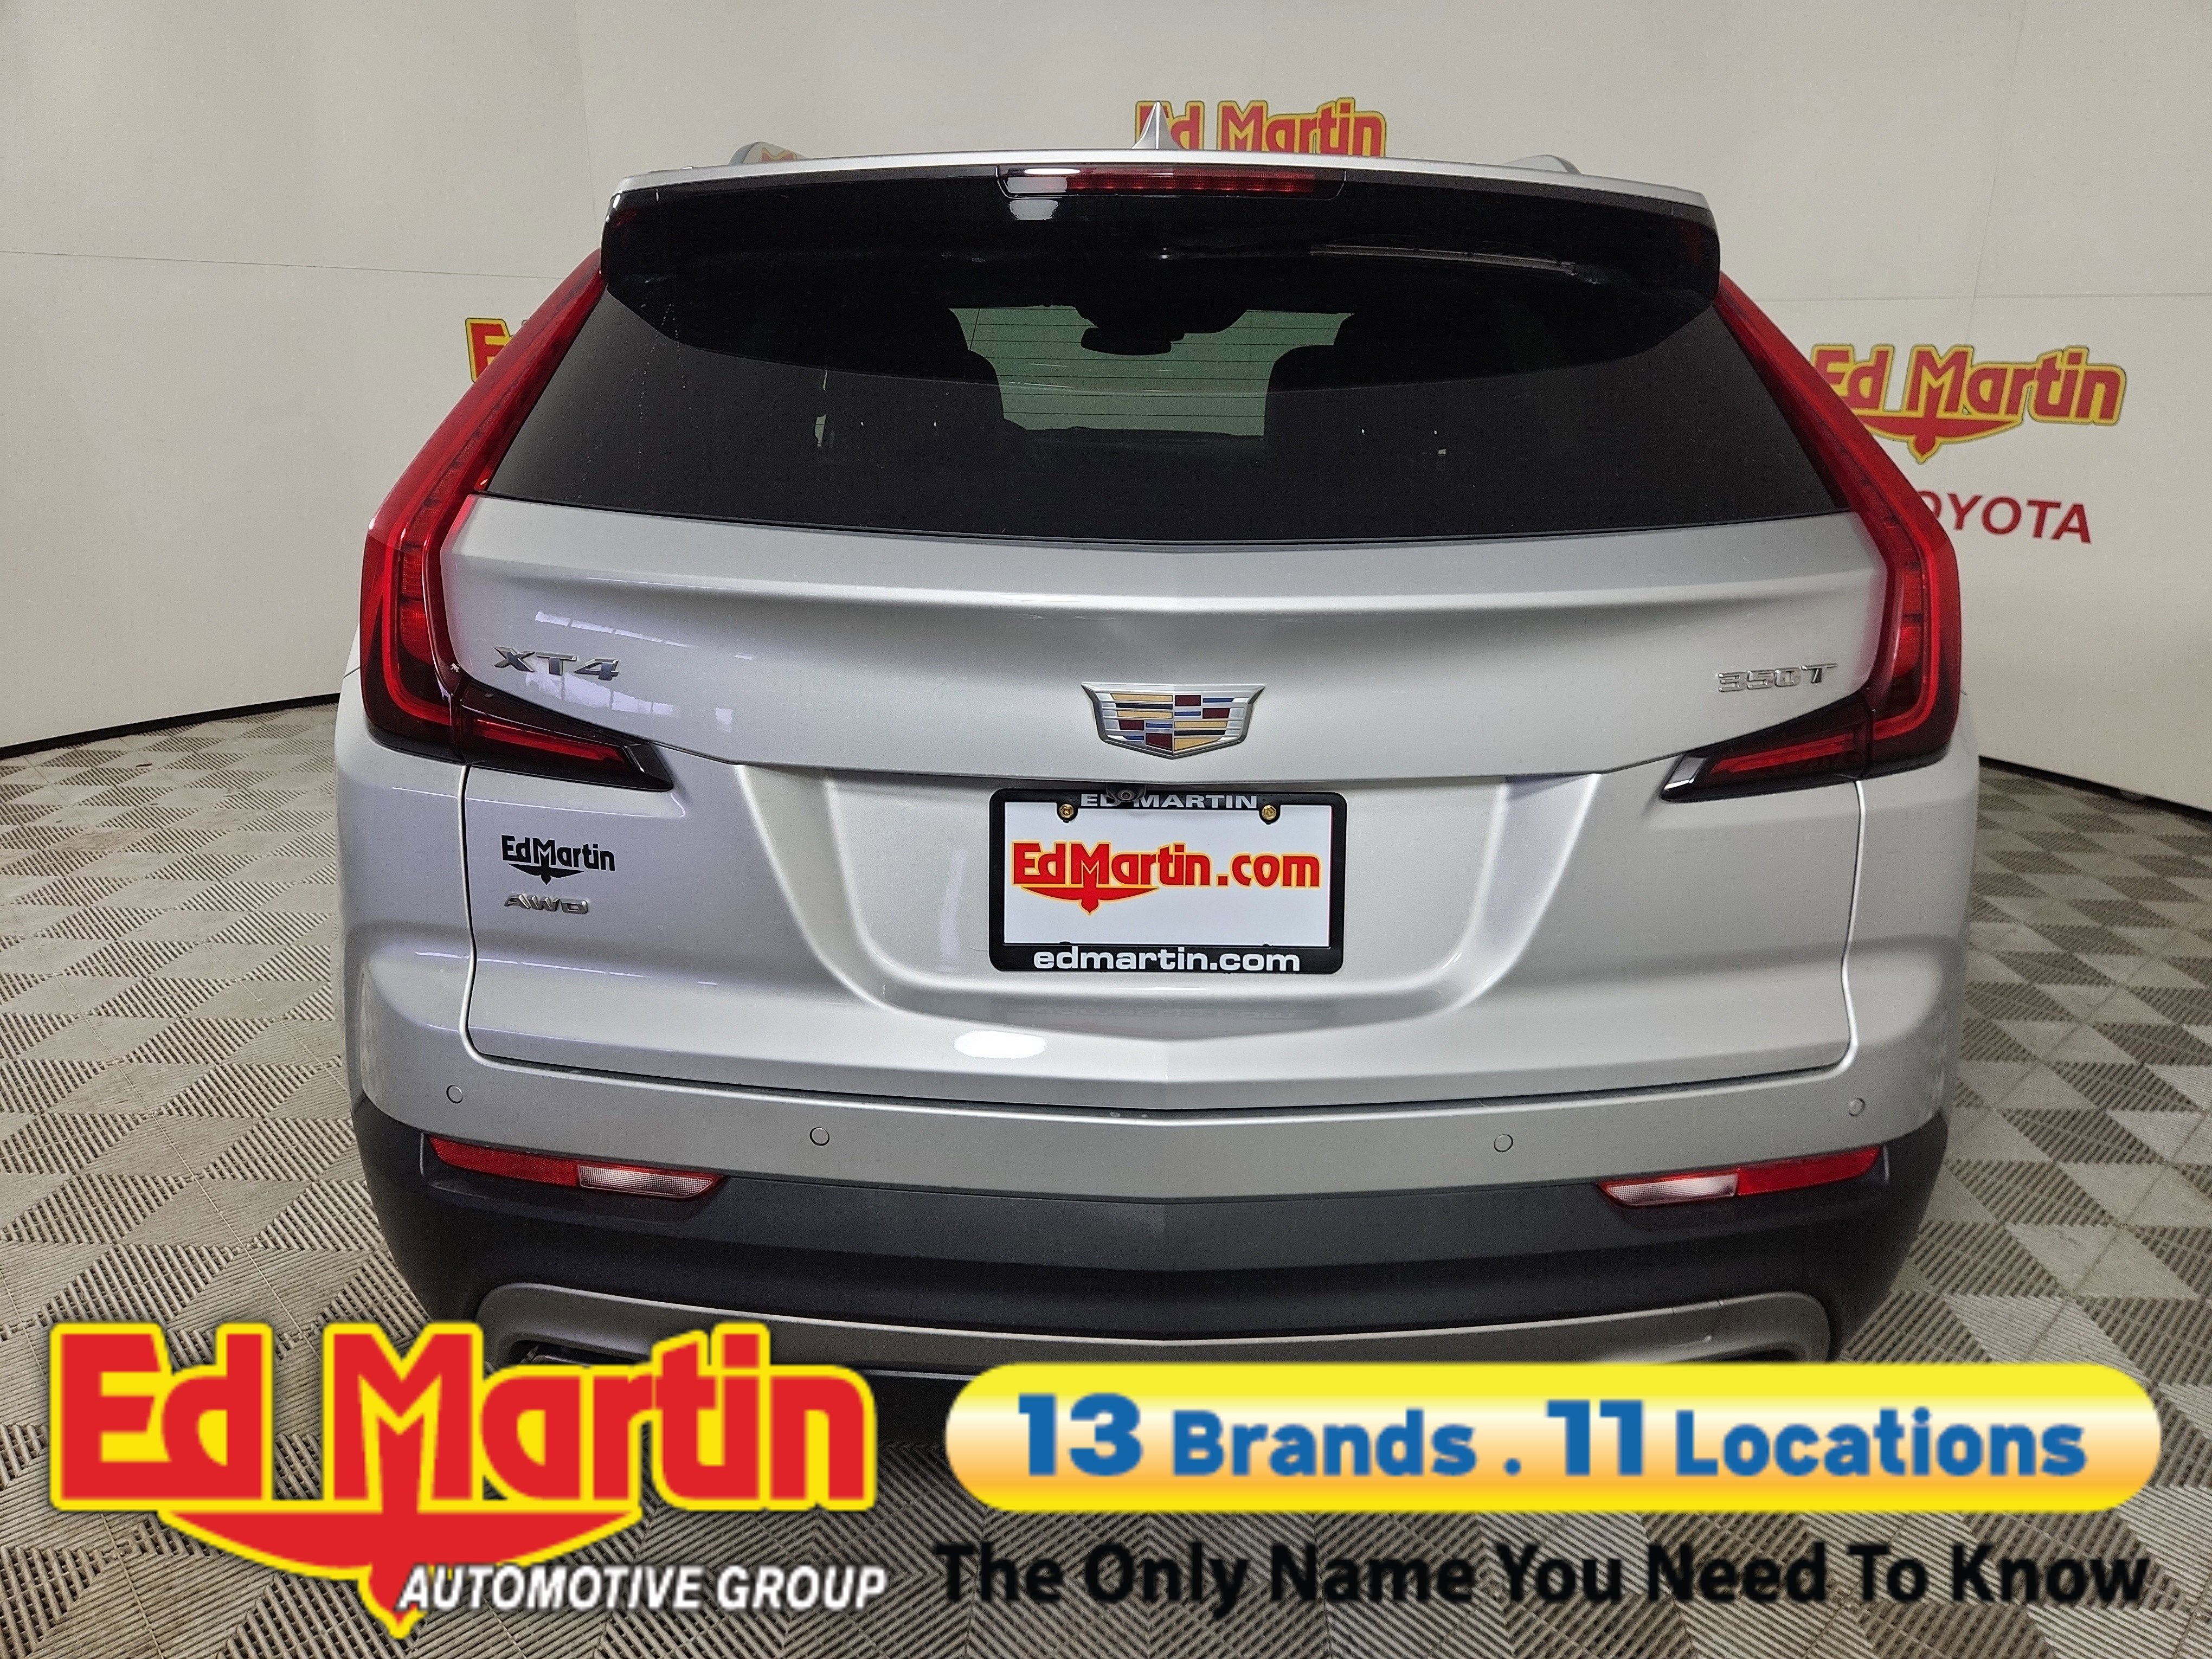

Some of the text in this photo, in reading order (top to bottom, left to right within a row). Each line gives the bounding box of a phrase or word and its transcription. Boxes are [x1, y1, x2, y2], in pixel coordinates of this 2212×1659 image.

[1218, 98, 1386, 157] Martin
[1810, 344, 2126, 426] Ed Martin
[1918, 490, 2092, 544] YOTA
[493, 646, 620, 681] XT4
[1081, 794, 1257, 808] ED MARTIN
[503, 893, 589, 915] AWD
[1033, 946, 1300, 972] edmartin.com
